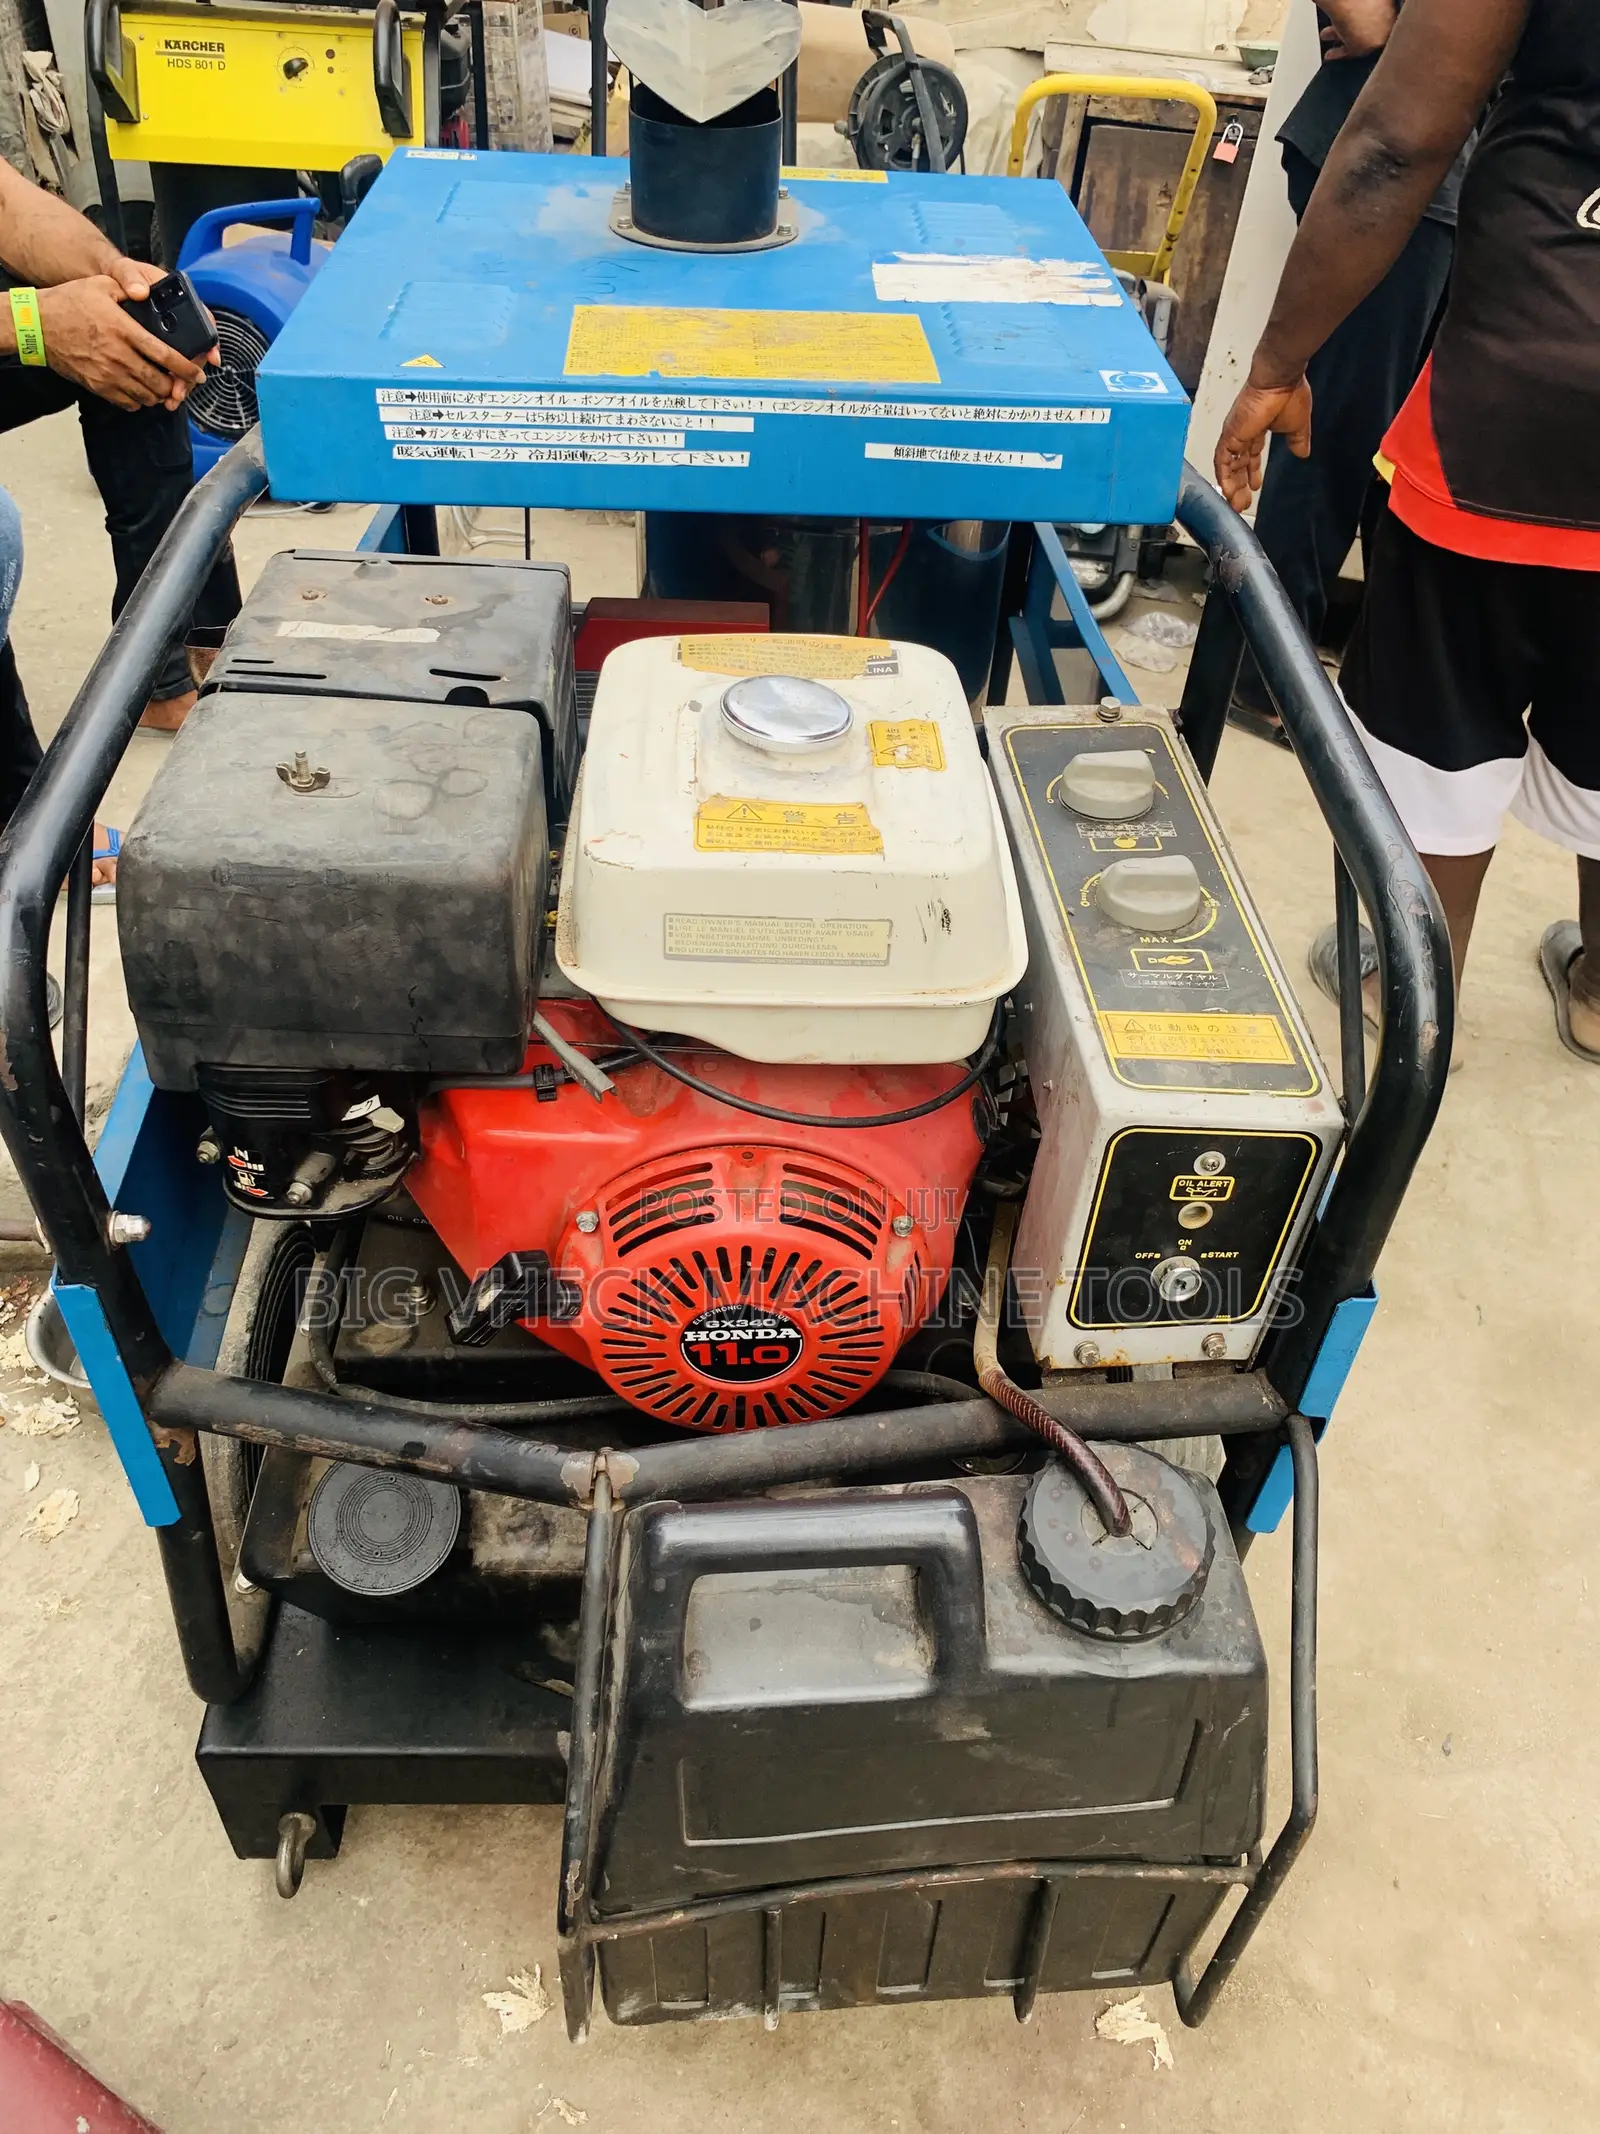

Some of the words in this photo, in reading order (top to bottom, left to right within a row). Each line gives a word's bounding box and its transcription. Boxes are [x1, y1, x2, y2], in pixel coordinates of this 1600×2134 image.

[167, 58, 192, 69] HDS
[195, 60, 213, 70] 801
[218, 61, 226, 70] D
[709, 926, 745, 934] MANUEL
[1140, 936, 1169, 944] MAX
[1178, 1180, 1194, 1188] OIL
[1196, 1180, 1230, 1188] ALERT
[1207, 1251, 1239, 1259] START
[692, 1304, 742, 1326] ELECTRONIC
[705, 1318, 777, 1329] GX340
[683, 1327, 802, 1342] HONDA
[689, 1342, 790, 1366] 11.0
